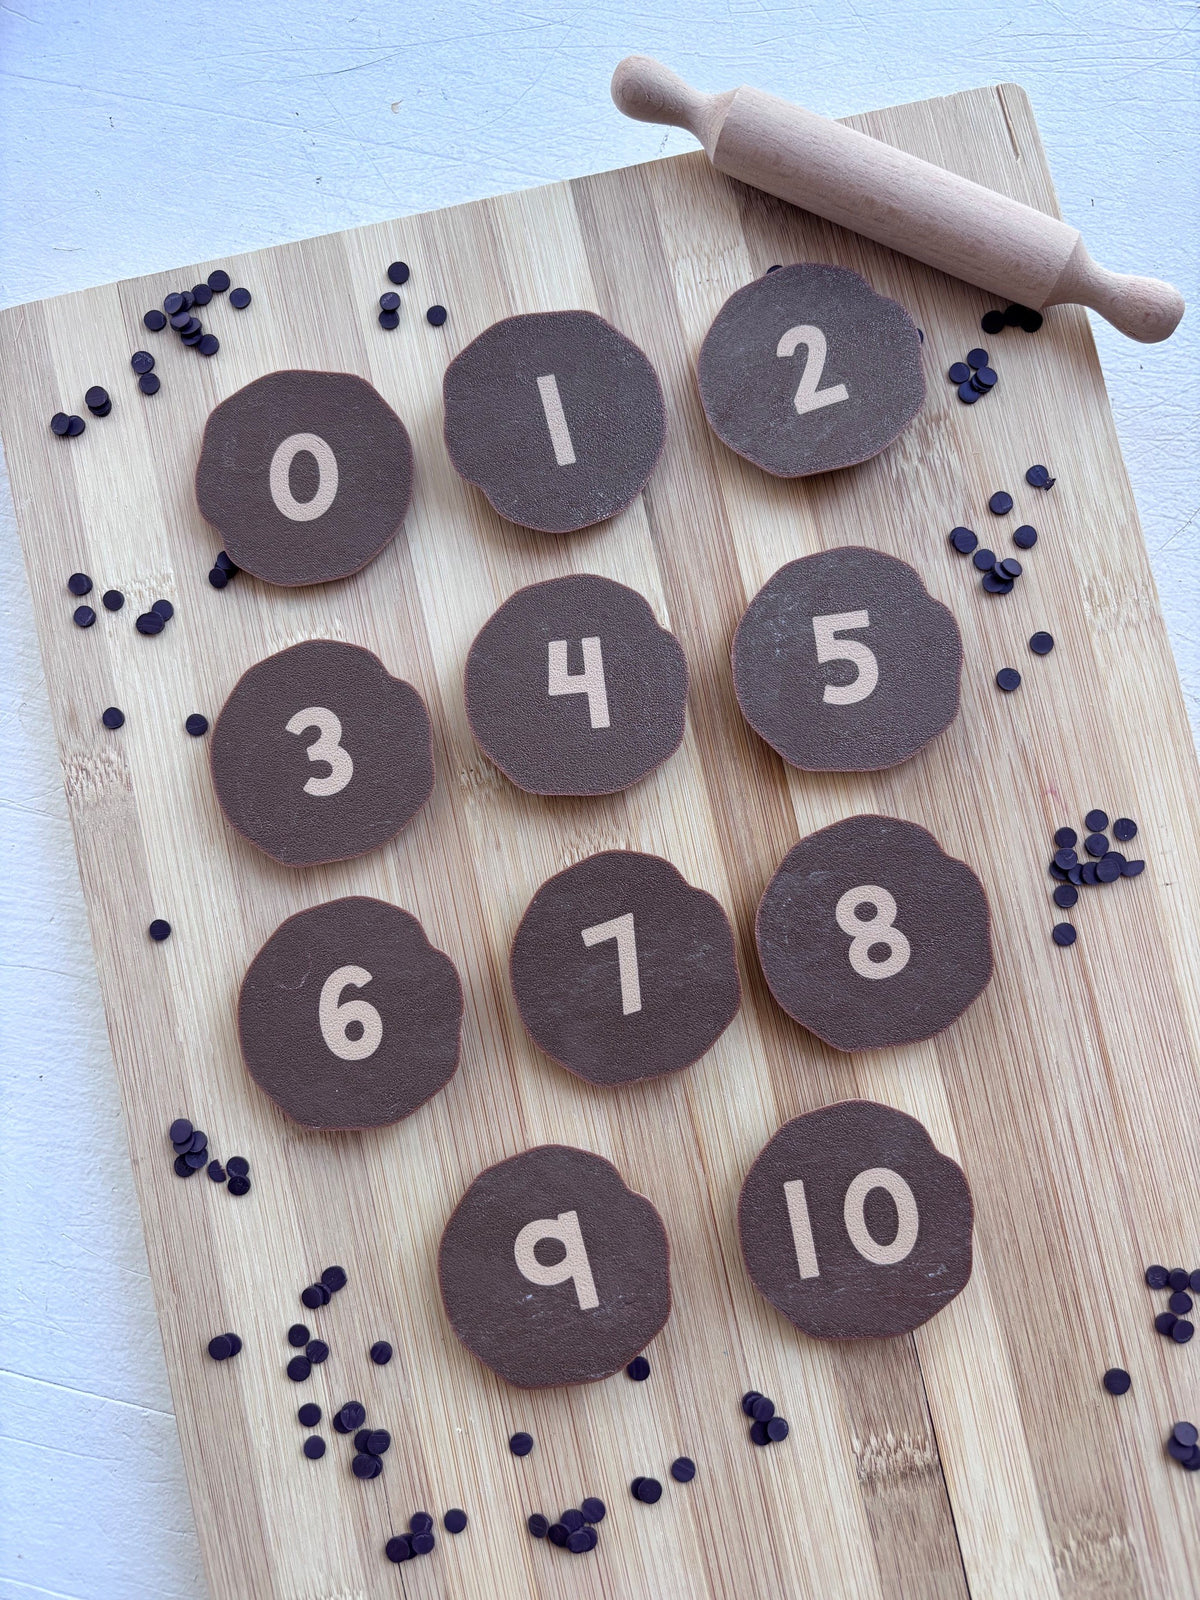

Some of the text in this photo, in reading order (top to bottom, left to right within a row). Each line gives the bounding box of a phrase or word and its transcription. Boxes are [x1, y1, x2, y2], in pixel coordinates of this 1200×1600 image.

[777, 325, 849, 414] 2
[537, 374, 577, 467] 1
[270, 433, 338, 521] 0
[548, 637, 611, 728] 4
[812, 610, 878, 705] 5
[286, 707, 353, 796] 3
[581, 913, 641, 1015] 7
[836, 885, 910, 979] 8
[319, 965, 383, 1060] 6
[514, 1211, 599, 1310] 9
[784, 1168, 919, 1279] 10
